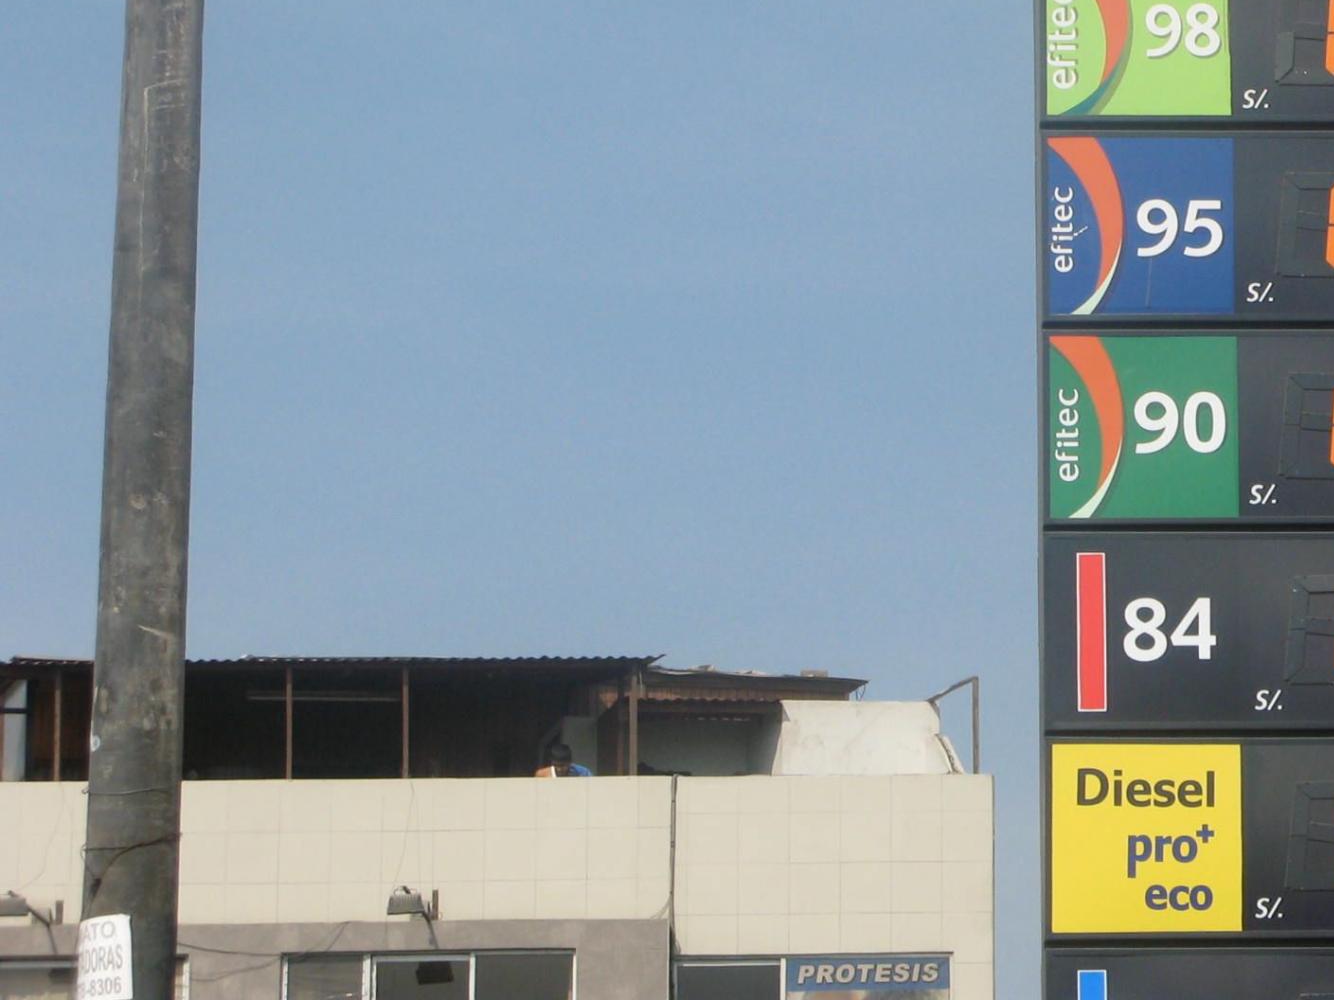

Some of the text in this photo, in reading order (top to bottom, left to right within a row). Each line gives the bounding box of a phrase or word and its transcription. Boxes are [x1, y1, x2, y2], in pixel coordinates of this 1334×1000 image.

[1144, 3, 1222, 59] 98
[1241, 89, 1270, 110] S/.
[1050, 186, 1075, 273] efitec
[1135, 199, 1224, 257] 95
[1246, 282, 1275, 303] S/.
[1055, 388, 1080, 482] efitec
[1133, 392, 1227, 454] 90
[1249, 484, 1278, 505] S/.
[1122, 597, 1217, 661] 84
[1255, 690, 1284, 711] S/.
[1075, 768, 1217, 808] Diesel
[1144, 880, 1214, 911] eco
[1255, 898, 1284, 919] S/.
[797, 962, 940, 985] PROTESIS
